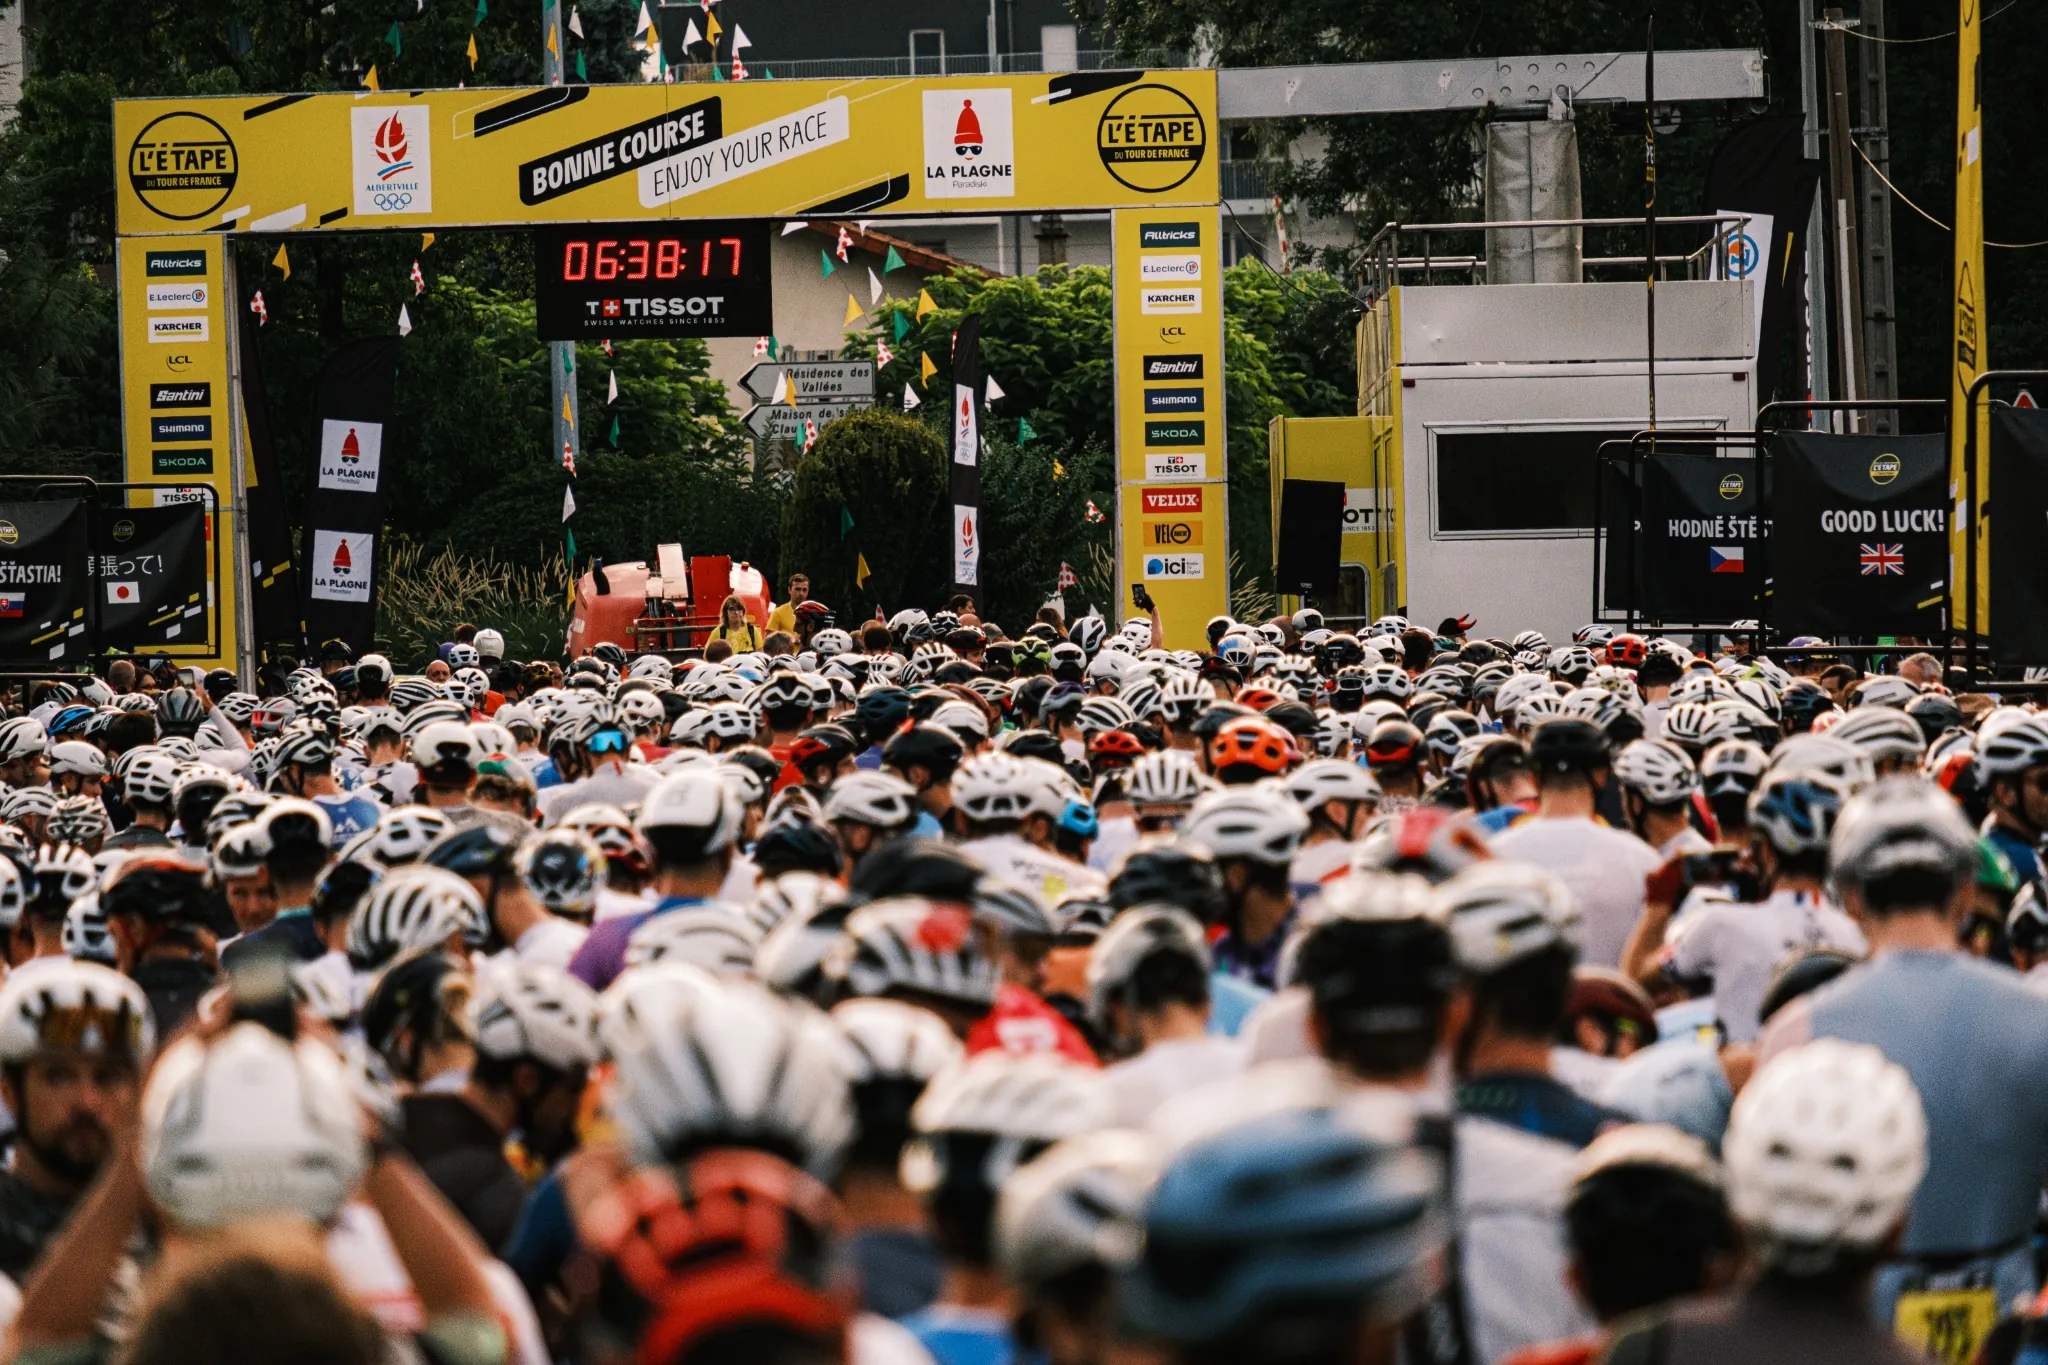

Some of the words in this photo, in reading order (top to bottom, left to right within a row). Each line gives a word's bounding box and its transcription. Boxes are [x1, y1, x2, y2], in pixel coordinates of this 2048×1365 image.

[533, 141, 615, 196] BONNE
[619, 109, 705, 164] COURSE
[653, 151, 714, 197] ENJOY
[720, 131, 773, 173] YOUR
[779, 111, 828, 150] RACE
[1114, 151, 1124, 160] DU
[1125, 149, 1146, 159] TOUR
[1147, 149, 1157, 158] DE
[1158, 148, 1190, 158] FRANCE
[927, 166, 946, 179] LA
[951, 164, 1012, 178] PLAGNE
[146, 179, 156, 188] DU
[156, 177, 178, 187] TOUR
[179, 177, 189, 187] DE
[190, 176, 222, 186] FRANCE
[365, 182, 419, 192] ALBERTVILLE
[952, 180, 988, 189] Paradiski
[1144, 231, 1196, 241] Alltricks
[150, 258, 203, 269] Alltricks
[1147, 294, 1195, 303] KÄRCHER
[623, 296, 725, 317] TISSOT
[154, 322, 203, 332] KÄRCHER
[619, 318, 664, 326] WATCHES
[669, 317, 698, 325] SINCE
[1162, 327, 1186, 336] LCL
[168, 354, 193, 365] LCL
[786, 367, 843, 379] Résidence
[850, 366, 869, 378] des
[1149, 360, 1198, 374] Santini
[802, 381, 843, 393] Vallées
[155, 389, 205, 402] Santini
[1151, 396, 1197, 405] SHIMANO
[771, 409, 812, 420] Maison
[818, 408, 832, 418] de
[158, 423, 205, 434] SHIMANO
[322, 467, 334, 476] LA
[337, 468, 376, 480] PLAGNE
[1154, 464, 1198, 474] TISSOT
[162, 493, 206, 503] TISSOT
[1146, 494, 1197, 507] VELUX
[1668, 515, 1725, 538] HODNĚ
[1821, 509, 1877, 533] GOOD
[1882, 508, 1945, 533] LUCK!
[1164, 557, 1186, 575] ici
[315, 577, 327, 587] LA
[329, 579, 367, 590] PLAGNE
